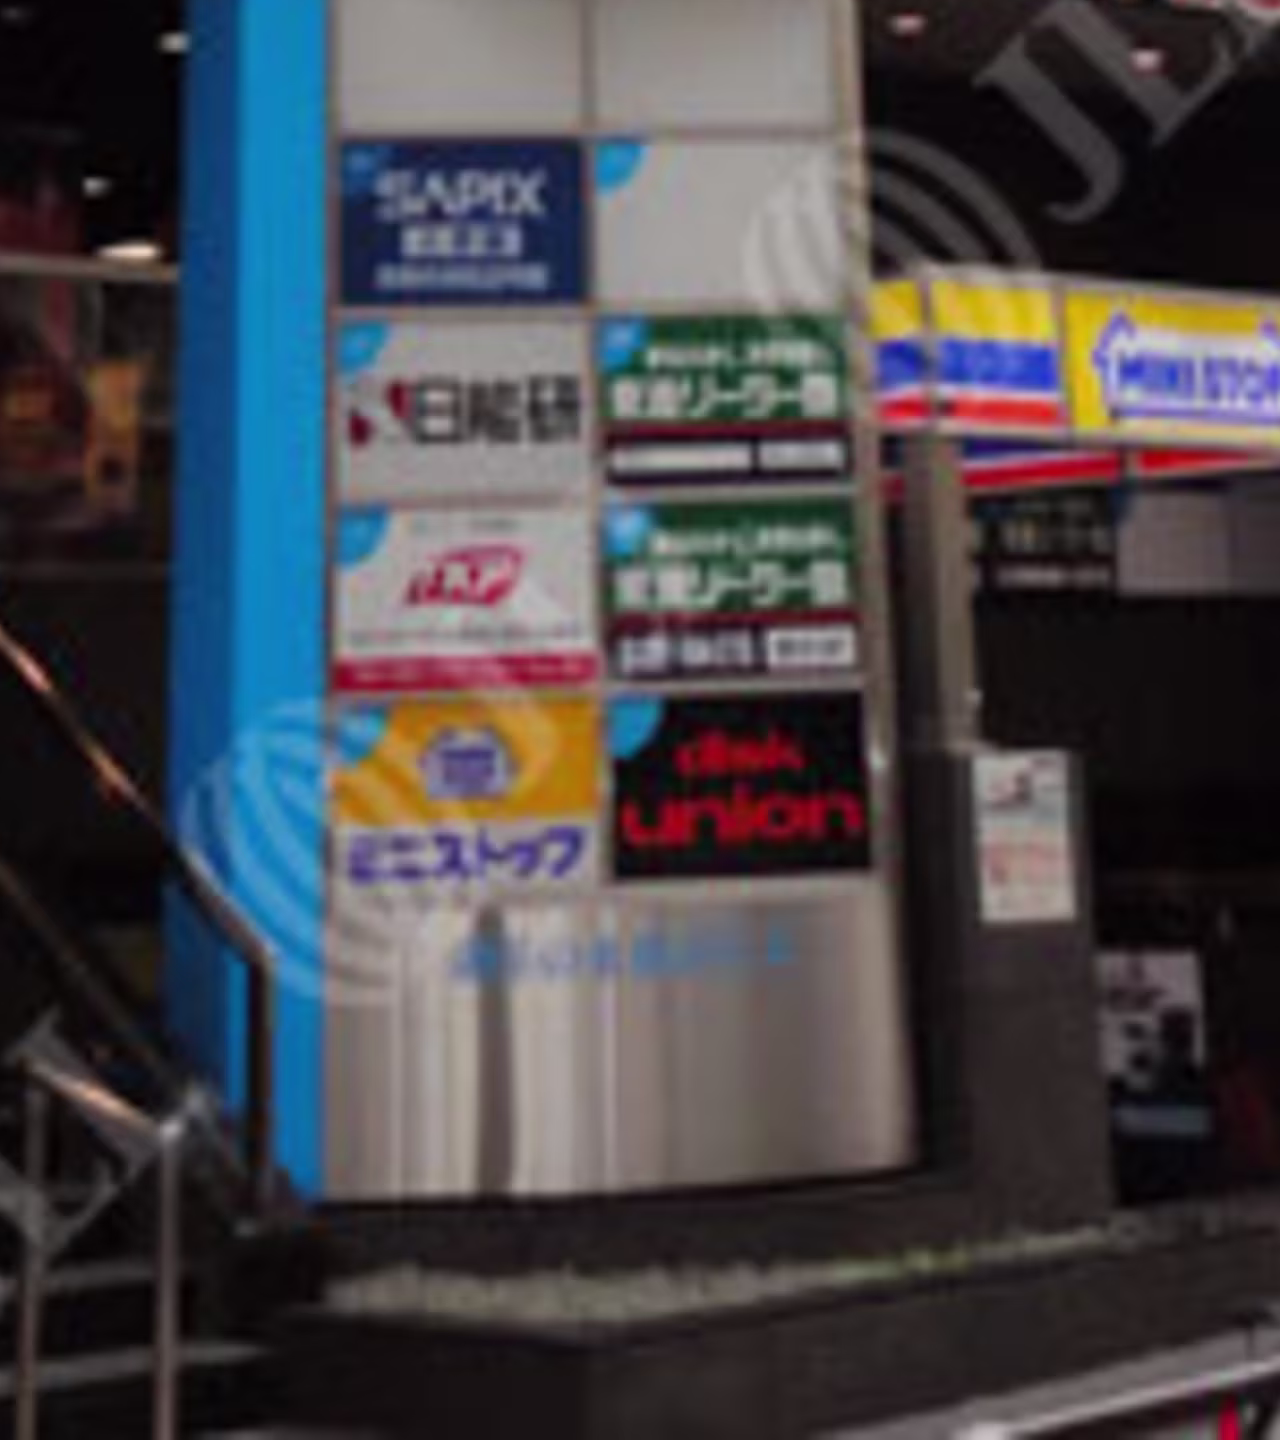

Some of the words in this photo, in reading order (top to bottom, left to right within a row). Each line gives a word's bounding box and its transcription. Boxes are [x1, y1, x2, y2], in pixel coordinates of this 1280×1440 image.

[375, 169, 547, 220] SAPIX
[412, 375, 582, 445] 日能研
[622, 782, 864, 846] union
[347, 826, 586, 886] ミニストップ
